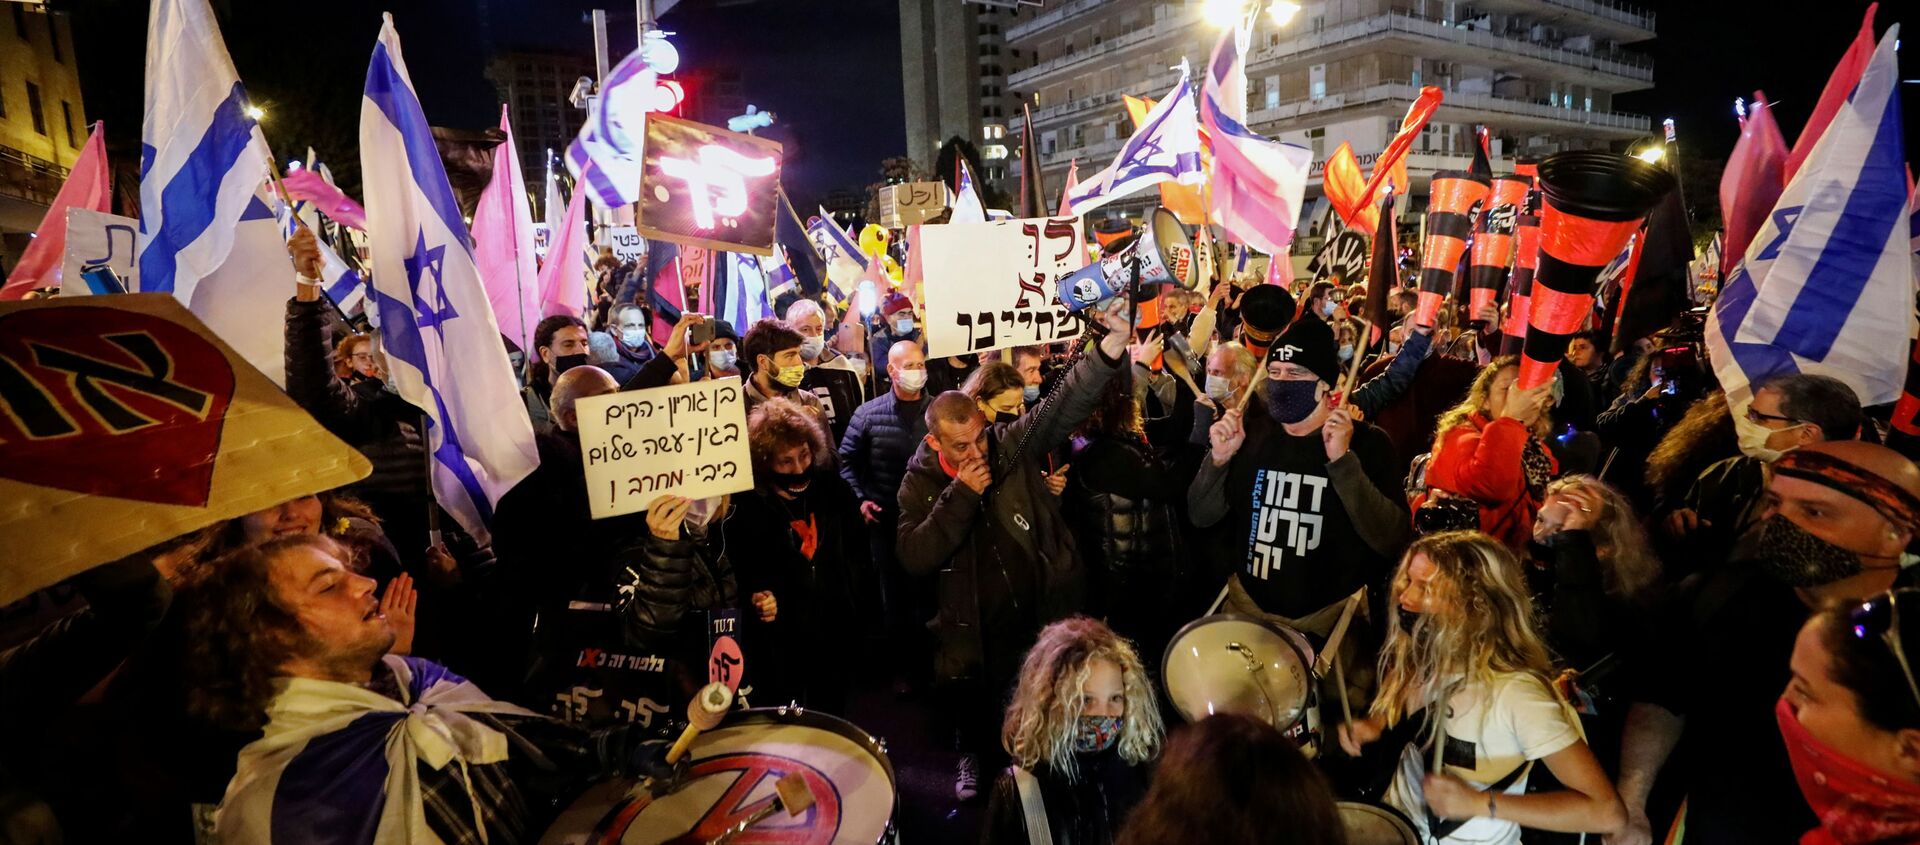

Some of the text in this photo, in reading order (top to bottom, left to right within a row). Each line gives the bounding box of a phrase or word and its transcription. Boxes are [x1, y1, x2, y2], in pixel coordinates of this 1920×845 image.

[606, 400, 653, 429] הקים
[714, 387, 736, 418] בן
[1265, 470, 1328, 512] דמו
[1256, 506, 1323, 557] קרט
[1252, 542, 1283, 580] יה
